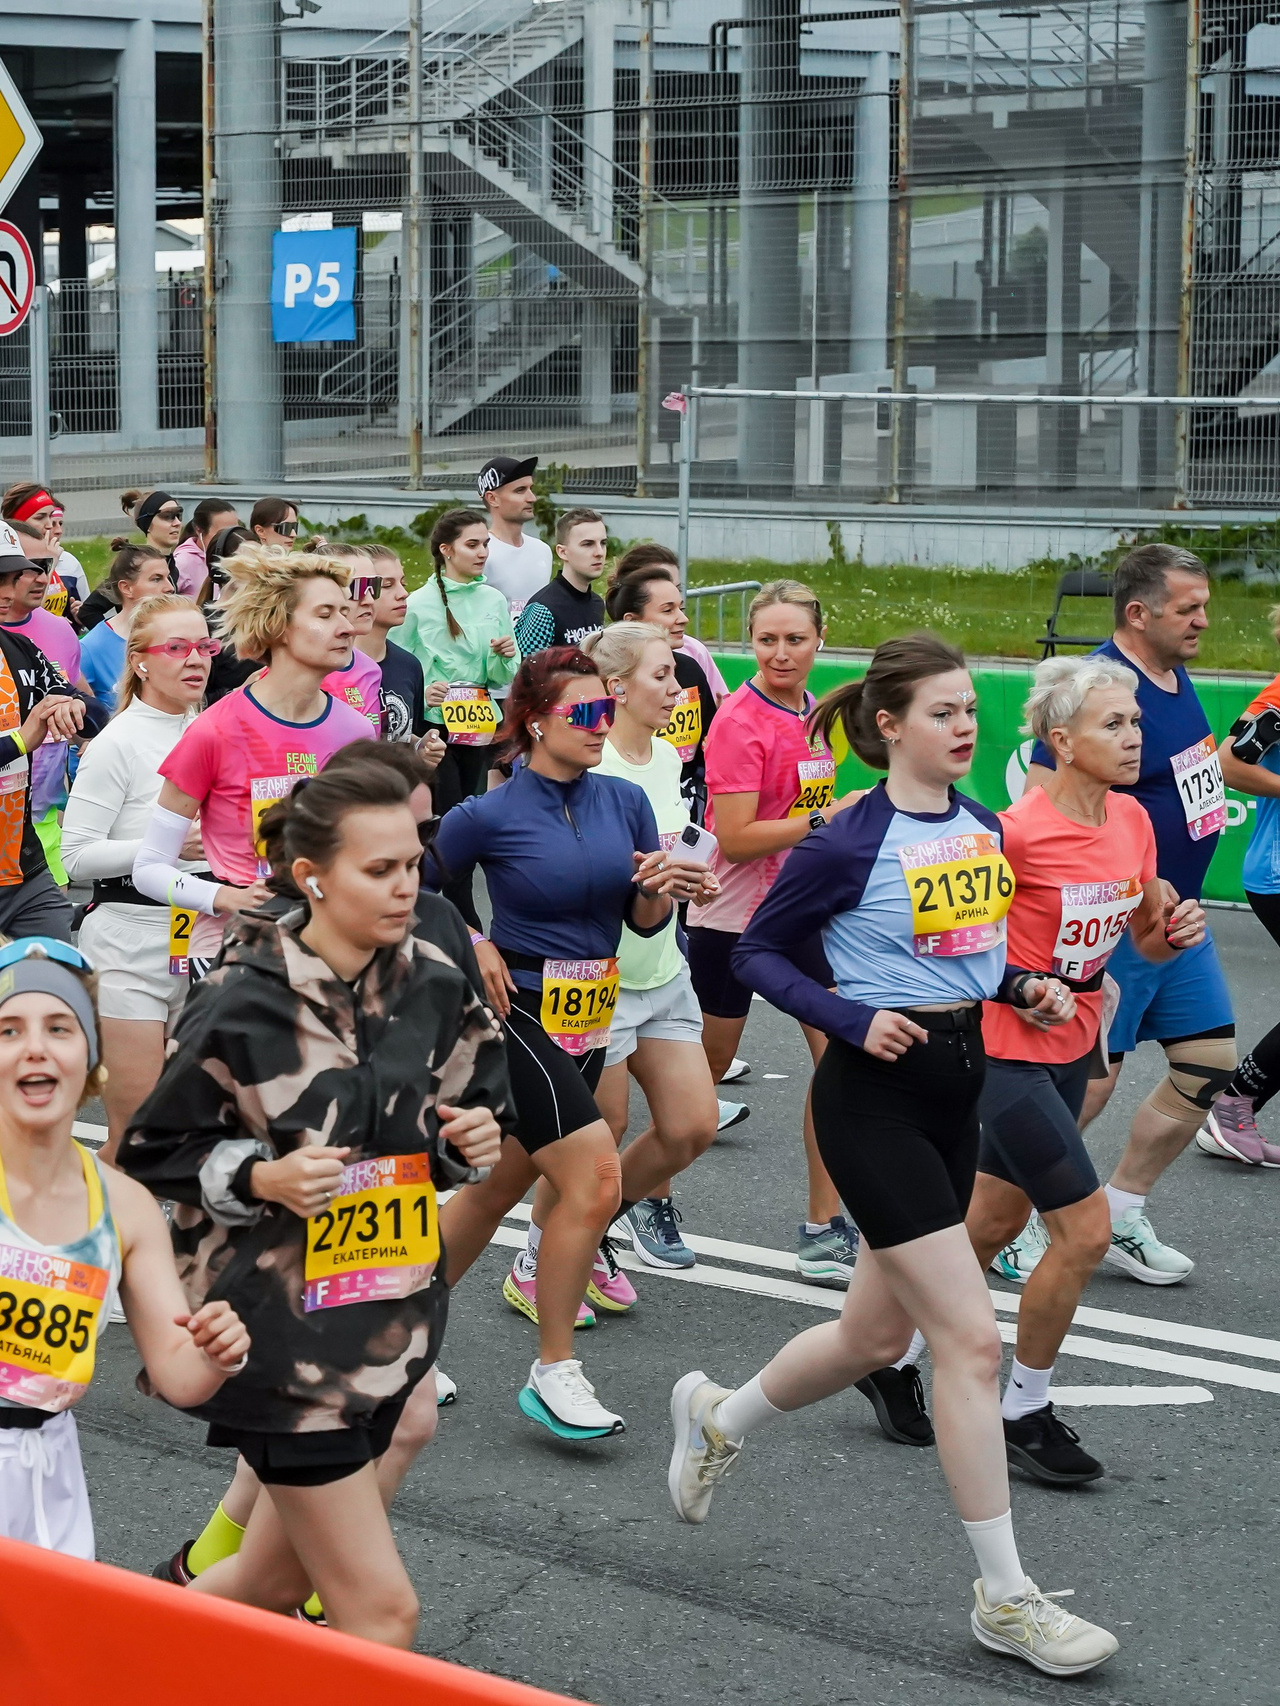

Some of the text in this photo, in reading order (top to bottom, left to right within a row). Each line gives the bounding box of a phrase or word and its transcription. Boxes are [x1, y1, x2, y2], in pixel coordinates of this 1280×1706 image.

[284, 262, 340, 308] P5
[445, 705, 494, 723] 20633
[286, 753, 317, 764] БЕЛЫЕ
[287, 763, 318, 774] НОЧИ
[253, 777, 288, 792] БЕЛЫЕ
[943, 835, 978, 855] НОЧИ
[905, 849, 969, 871] МАРАФОН
[914, 864, 1012, 913] 21376
[1063, 880, 1130, 899] БЕЛЫЕ НОЧИ
[955, 907, 989, 921] АРИНА
[927, 936, 941, 953] F
[546, 961, 580, 974] БЕЛЫЕ
[1066, 961, 1079, 975] F
[549, 983, 617, 1016] 18194
[355, 1158, 396, 1181] НОЧИ
[313, 1195, 428, 1252] 27311
[23, 1251, 71, 1279] НОЧИ
[333, 1246, 407, 1265] ЕКАТЕРИНА
[317, 1281, 329, 1305] F
